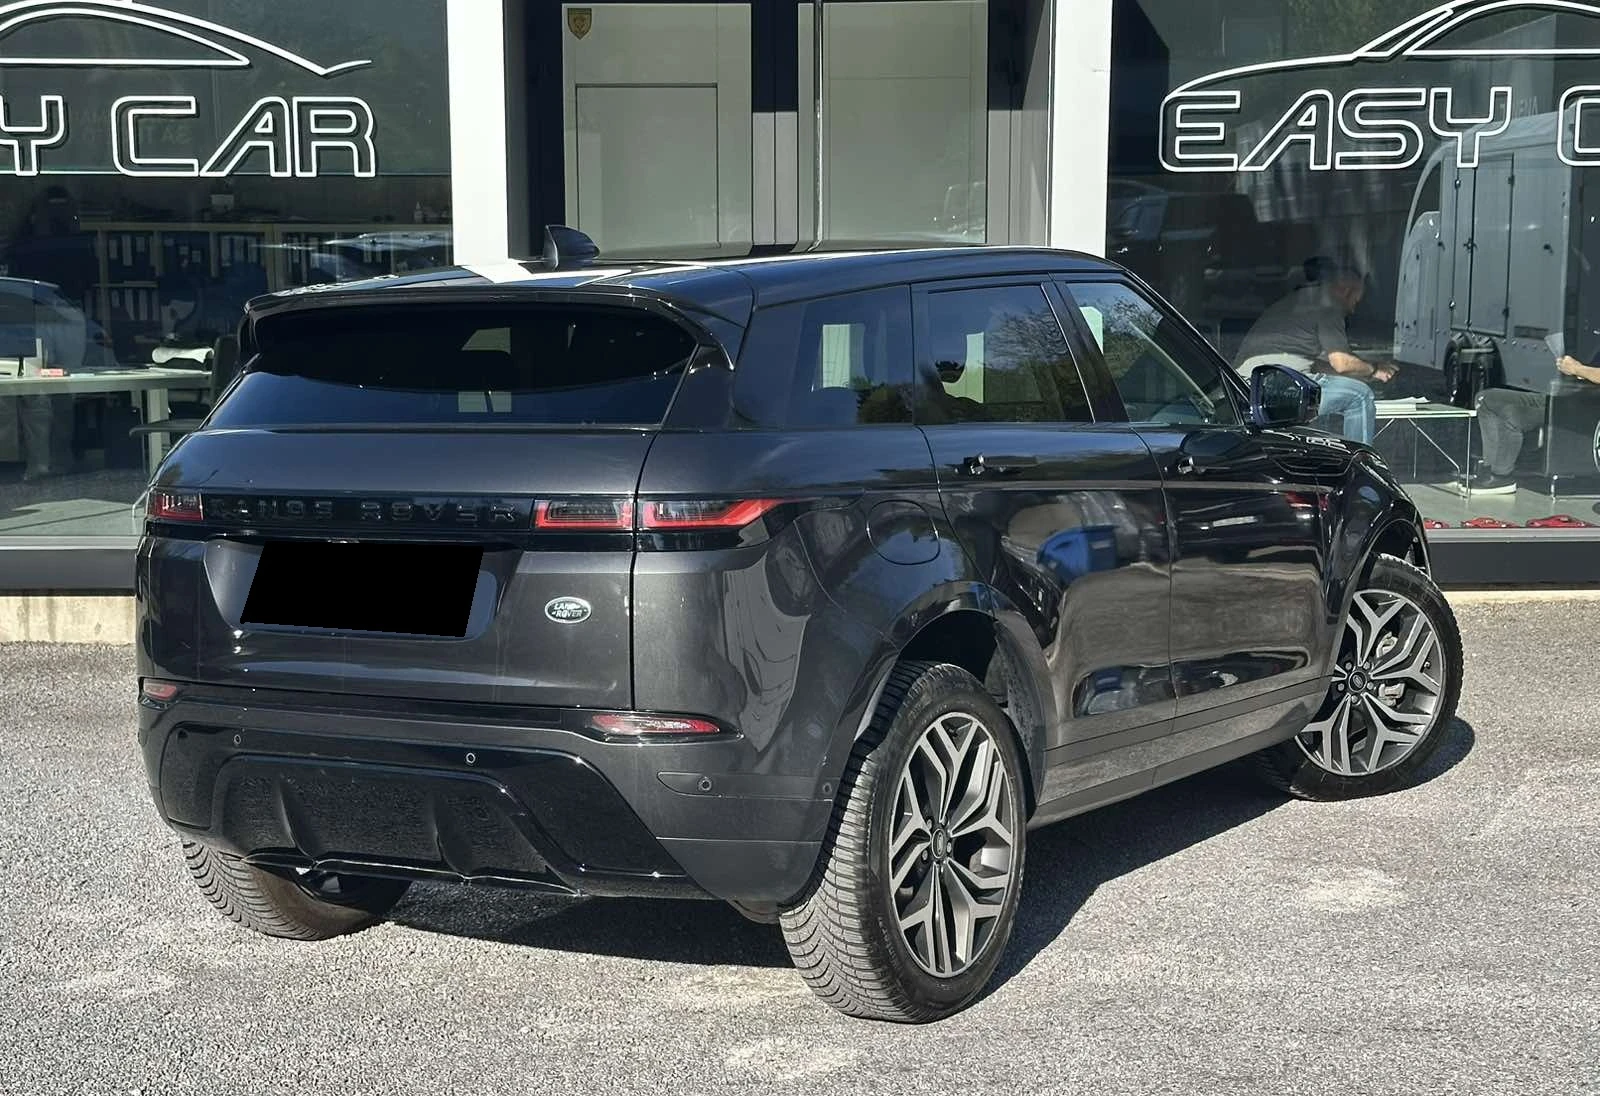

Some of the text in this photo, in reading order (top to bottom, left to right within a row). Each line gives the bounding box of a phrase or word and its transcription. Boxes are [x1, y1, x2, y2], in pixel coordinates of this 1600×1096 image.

[111, 96, 376, 178] CAR
[1159, 86, 1513, 173] EASY
[359, 501, 516, 522] ROVER
[555, 609, 583, 618] ROVER
